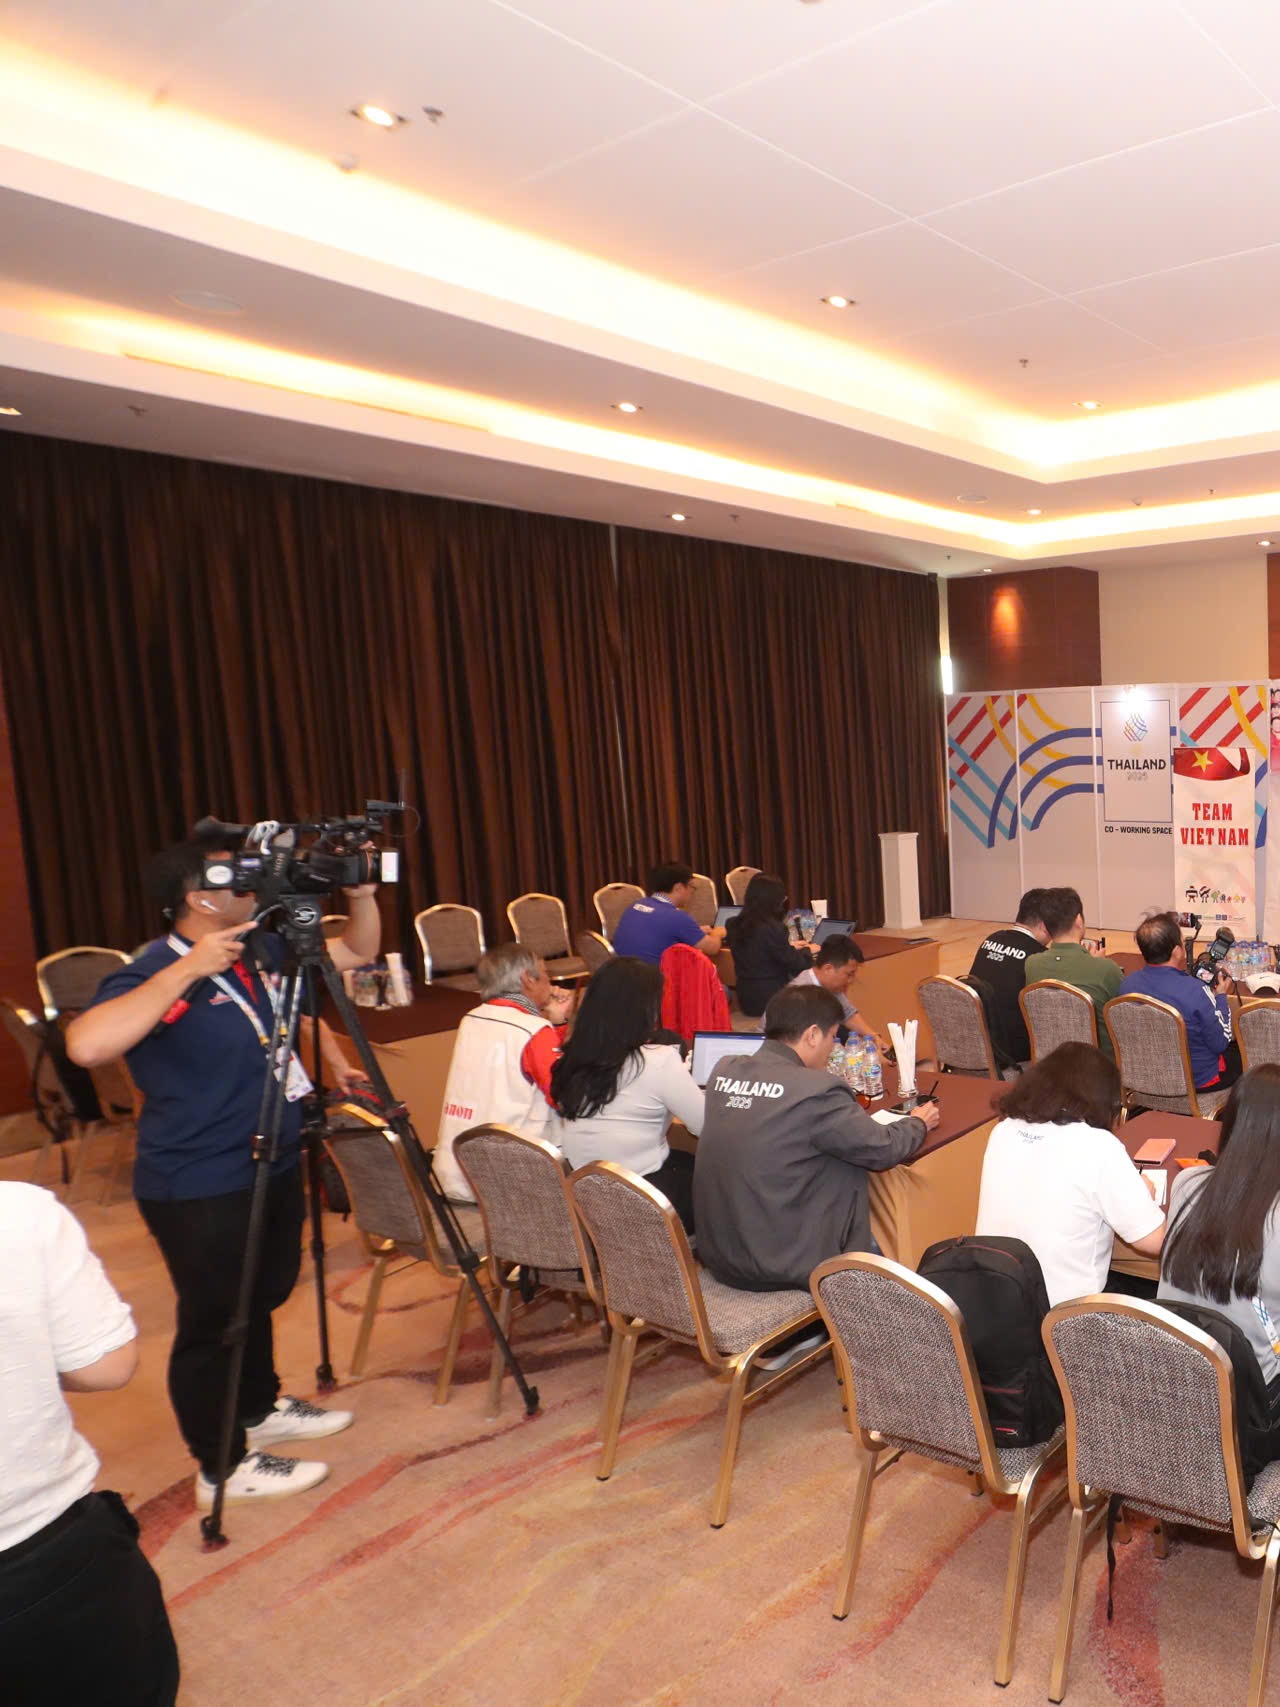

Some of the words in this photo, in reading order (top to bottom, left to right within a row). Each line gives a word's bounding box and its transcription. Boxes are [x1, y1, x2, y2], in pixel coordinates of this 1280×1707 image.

[1107, 759, 1166, 770] THAILAND
[1192, 803, 1232, 821] TEAM
[1152, 827, 1173, 835] SPACE
[1180, 828, 1214, 845] VIET
[1218, 828, 1249, 846] NAM
[981, 940, 1026, 960] THAILAND
[987, 951, 1005, 962] 2025
[714, 1076, 785, 1099] THAILAND
[725, 1096, 753, 1110] 2025
